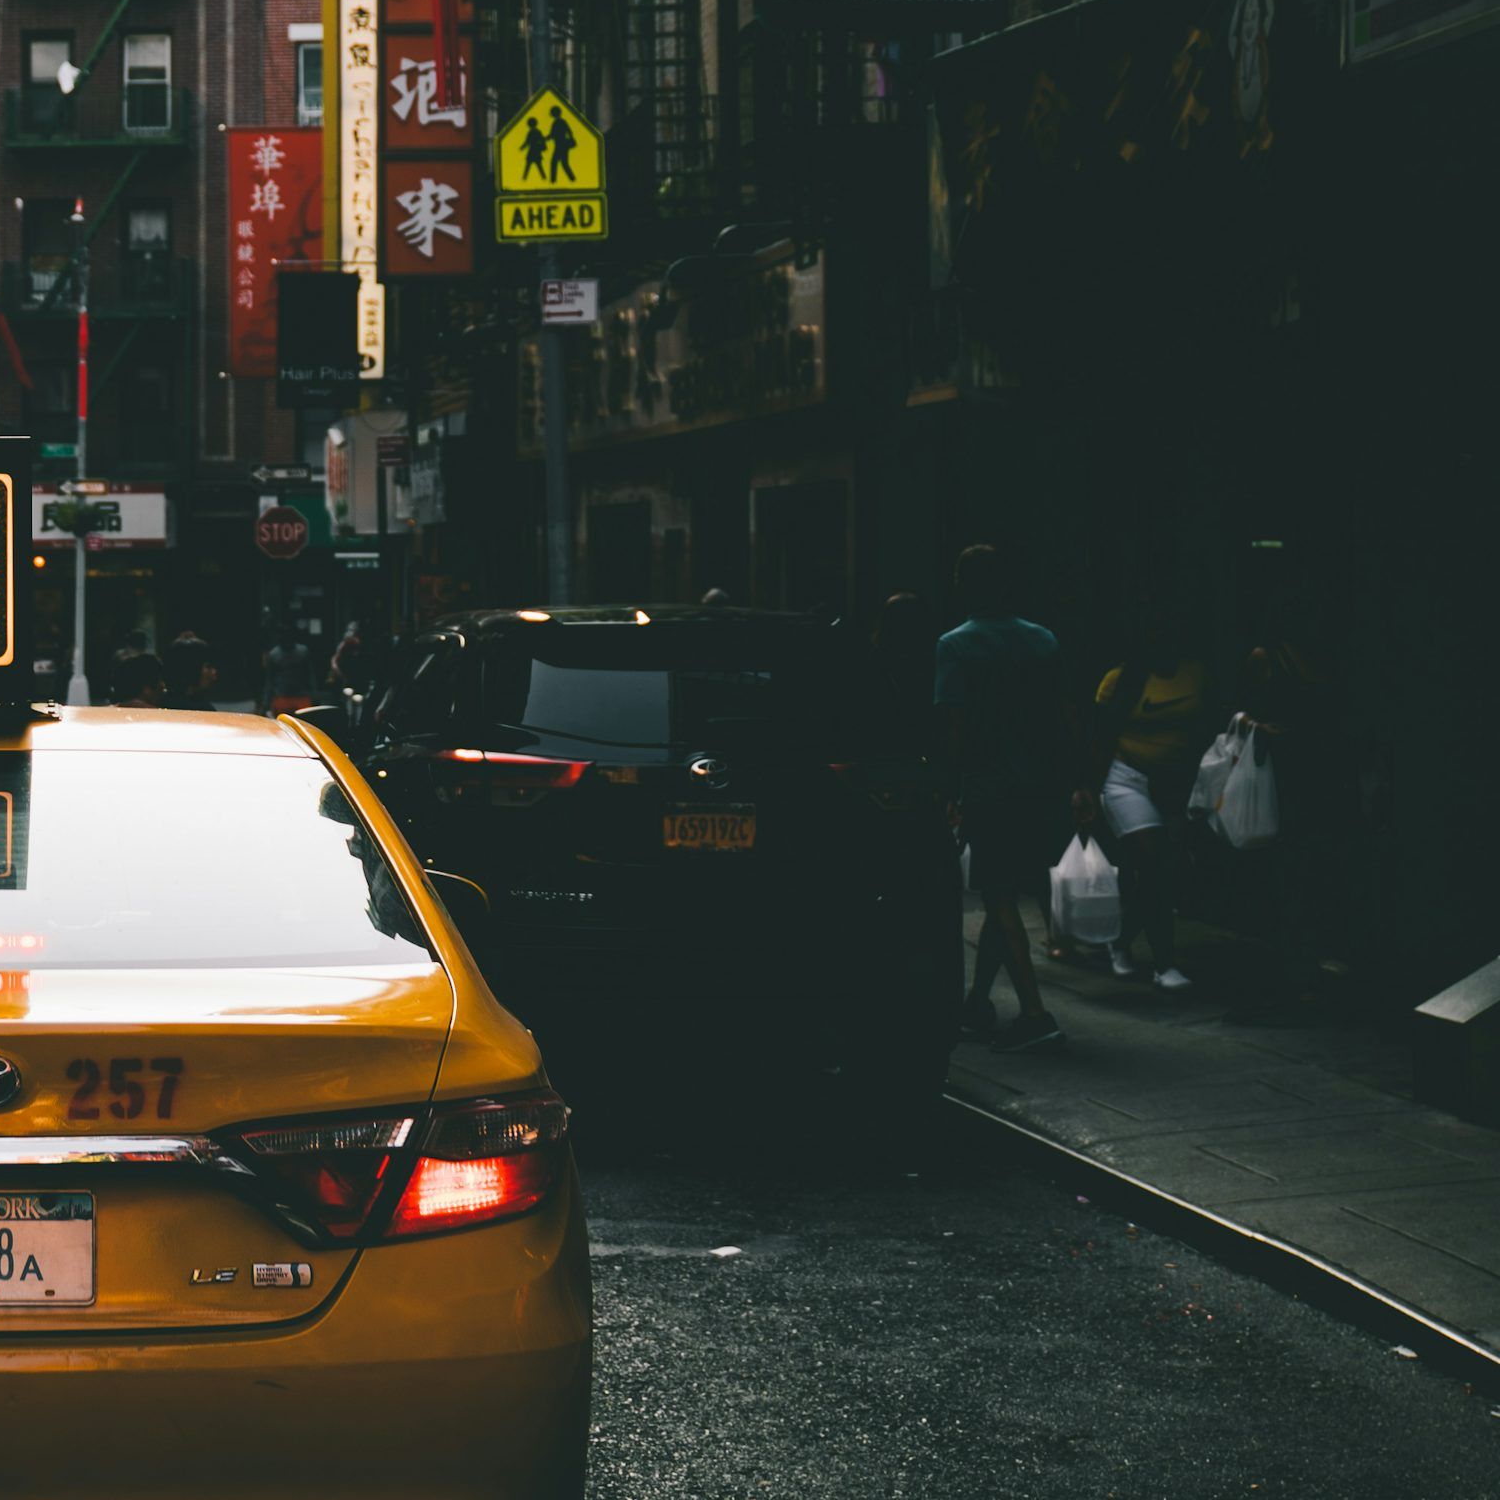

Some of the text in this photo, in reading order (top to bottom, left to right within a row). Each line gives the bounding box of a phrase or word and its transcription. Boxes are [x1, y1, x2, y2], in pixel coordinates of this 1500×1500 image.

[248, 133, 287, 221] 華埠
[510, 202, 596, 231] AHEAD
[280, 365, 356, 381] Hair Plus
[260, 522, 306, 543] STOP
[64, 1056, 186, 1121] 257
[190, 1267, 238, 1284] LE
